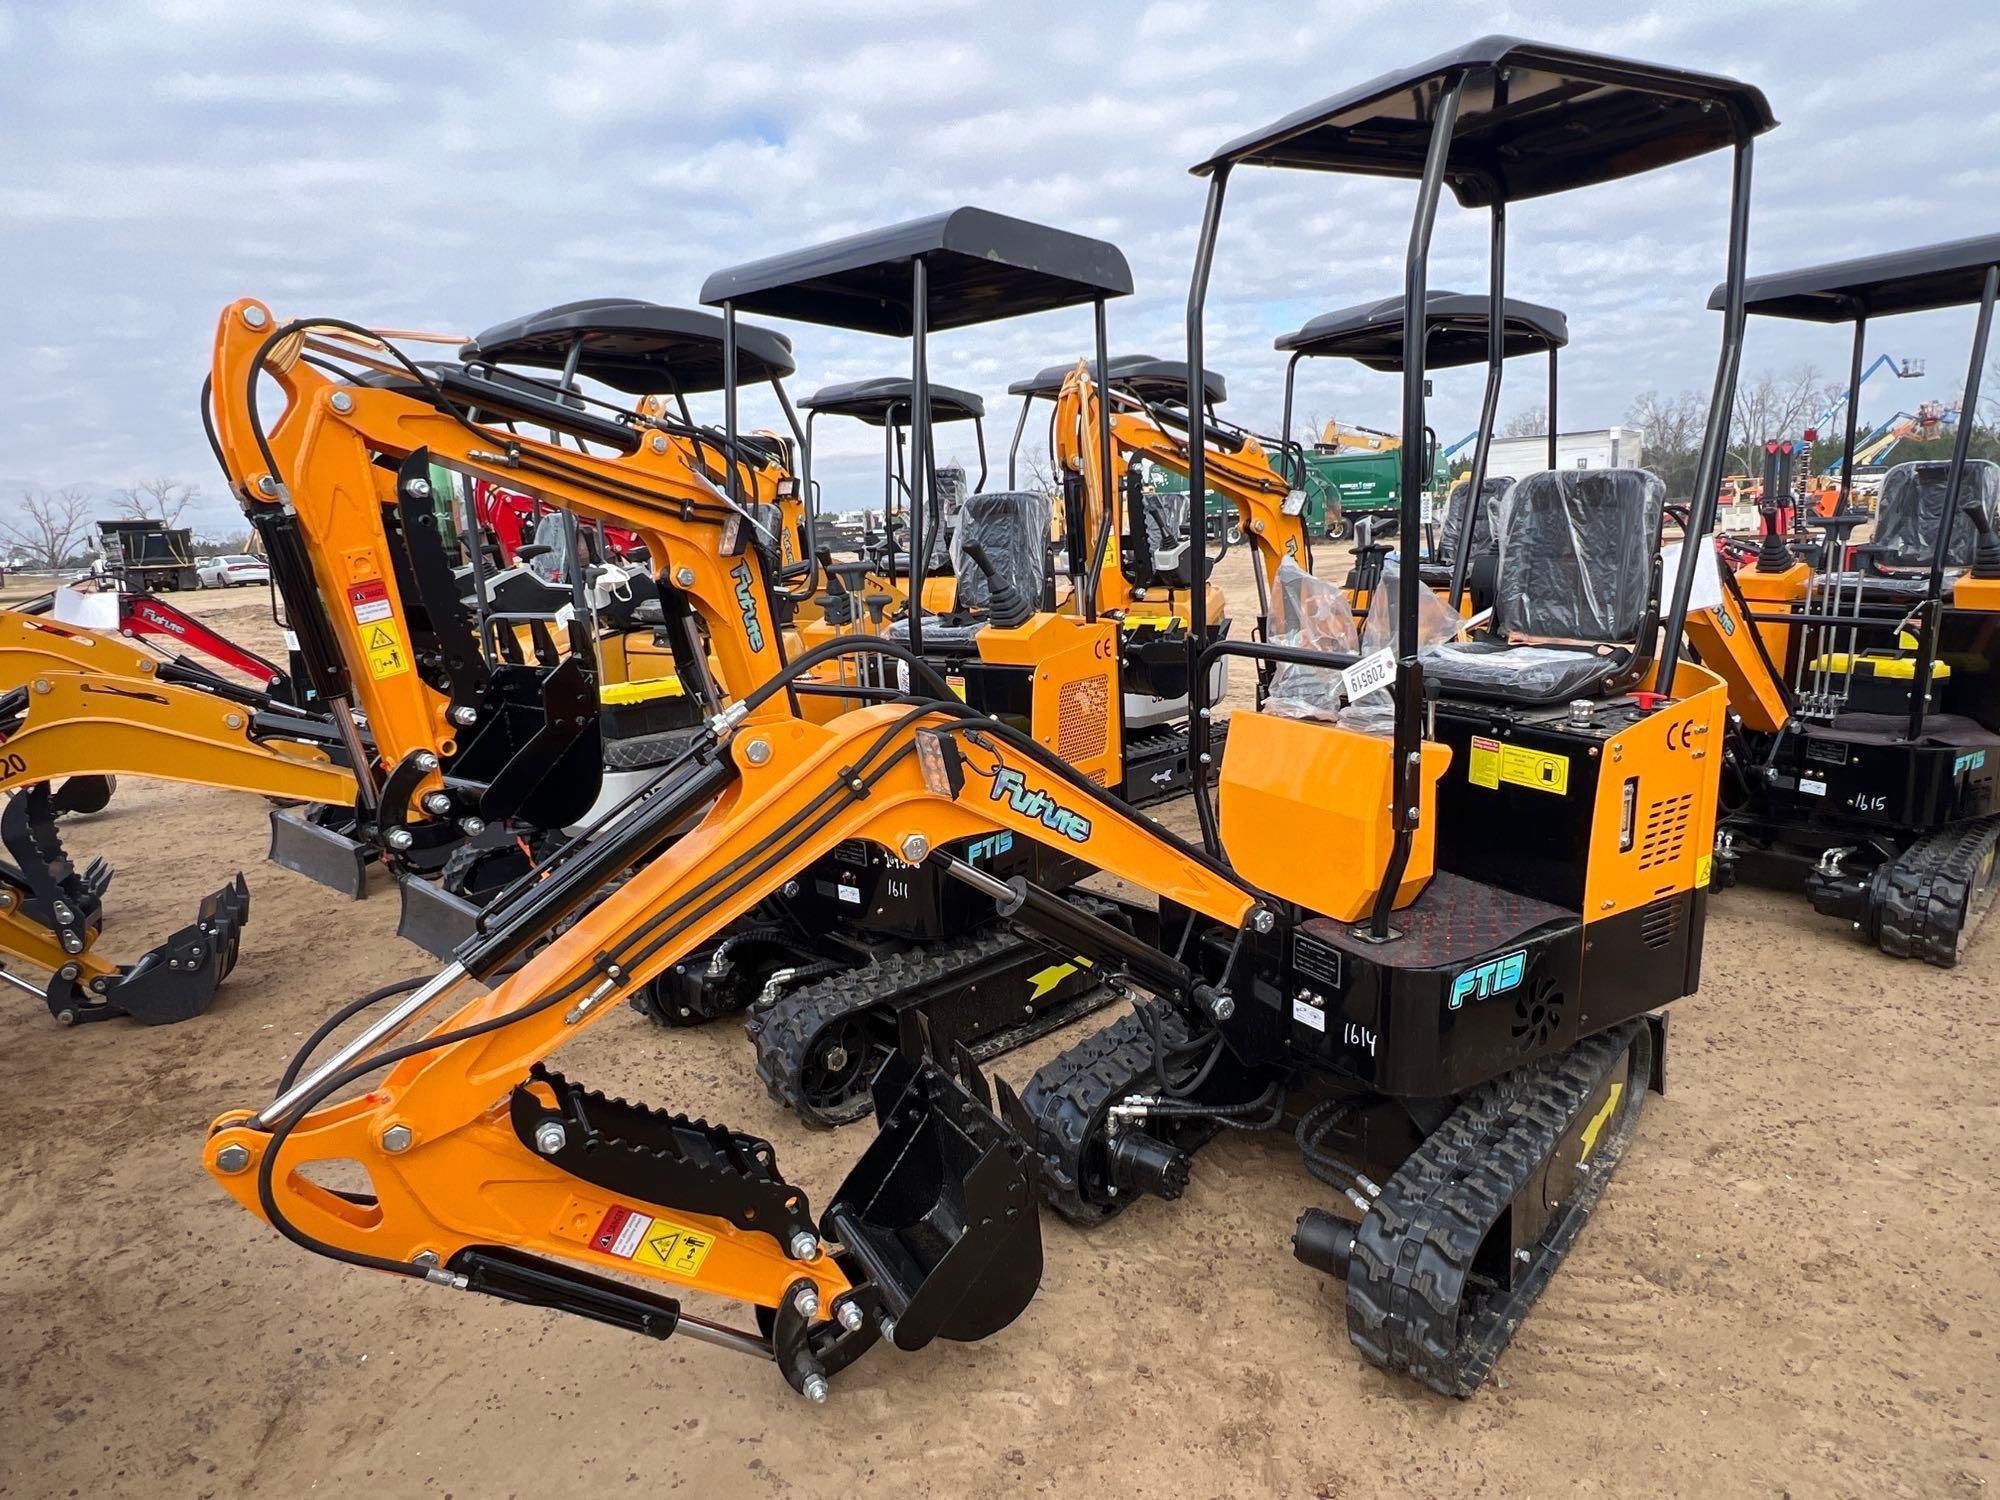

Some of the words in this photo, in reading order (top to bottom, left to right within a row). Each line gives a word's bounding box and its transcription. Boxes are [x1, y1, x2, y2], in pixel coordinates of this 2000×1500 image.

[142, 606, 185, 635] Future
[730, 558, 765, 653] Future
[1095, 638, 1111, 659] CE
[1351, 665, 1386, 692] 209519
[1667, 719, 1694, 751] CE
[990, 765, 1092, 843] Future
[1855, 792, 1887, 811] 1615
[969, 830, 1013, 867] FT15
[888, 879, 908, 899] 1611
[1449, 950, 1526, 1009] FT13
[1344, 1022, 1377, 1056] 1614
